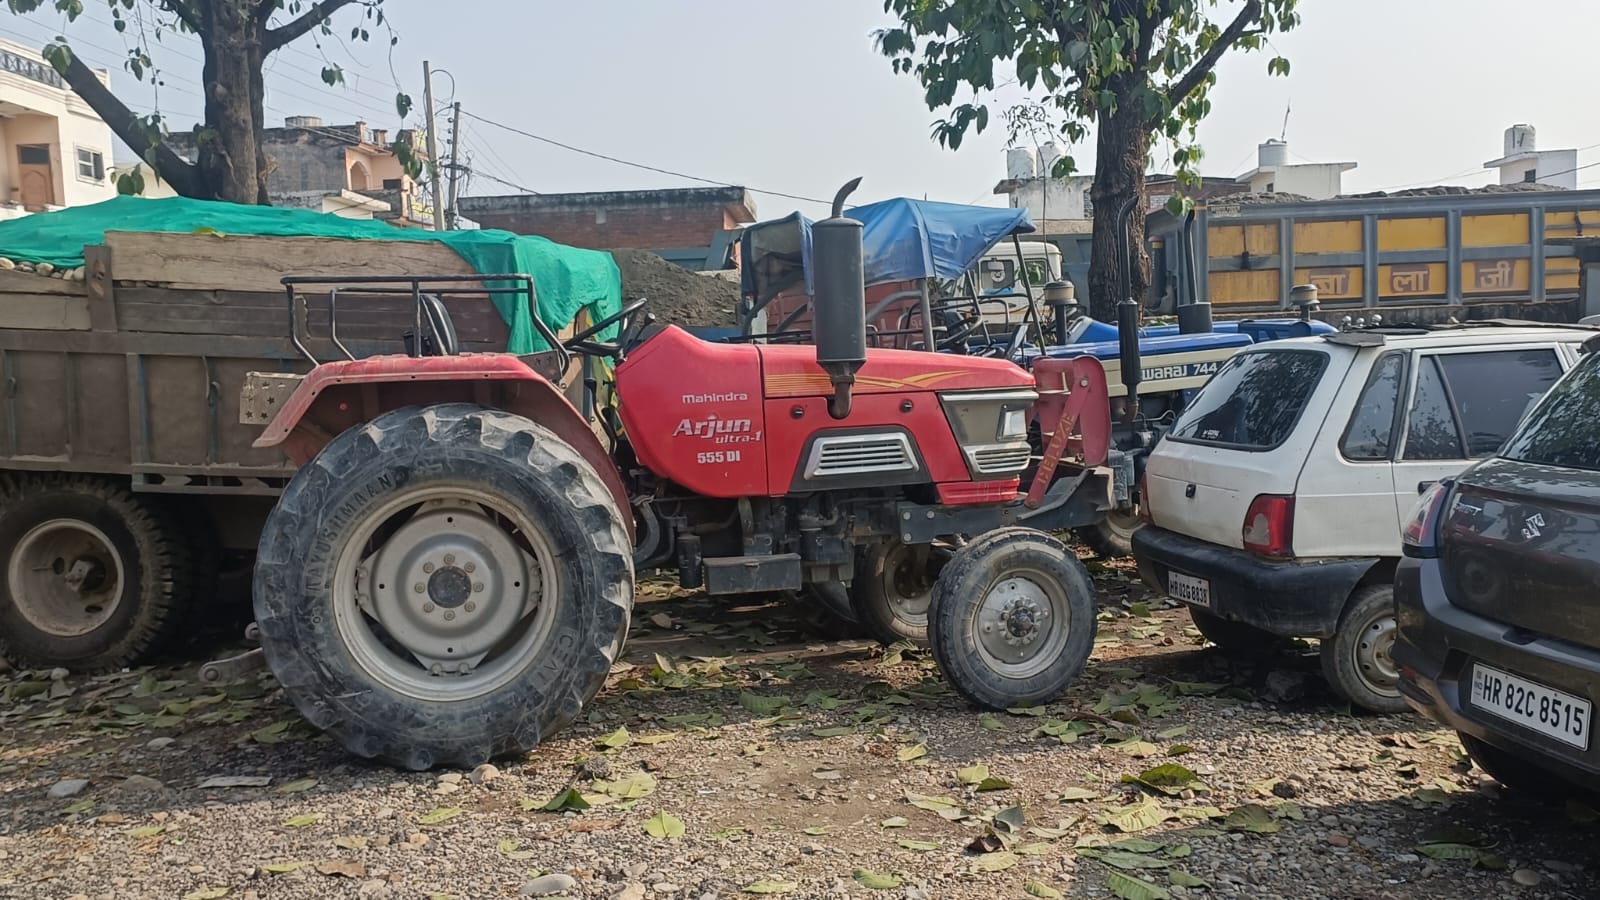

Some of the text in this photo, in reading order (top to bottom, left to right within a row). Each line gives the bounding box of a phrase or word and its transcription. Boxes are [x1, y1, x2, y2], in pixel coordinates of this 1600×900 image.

[1392, 270, 1428, 292] ला
[1479, 260, 1511, 289] जी
[1193, 362, 1218, 376] 744
[682, 392, 748, 404] Mahindra
[672, 414, 752, 439] Arjun
[715, 430, 762, 444] ultra-1
[697, 450, 741, 464] 555 DI
[1482, 674, 1585, 737] HR 82C 8515
